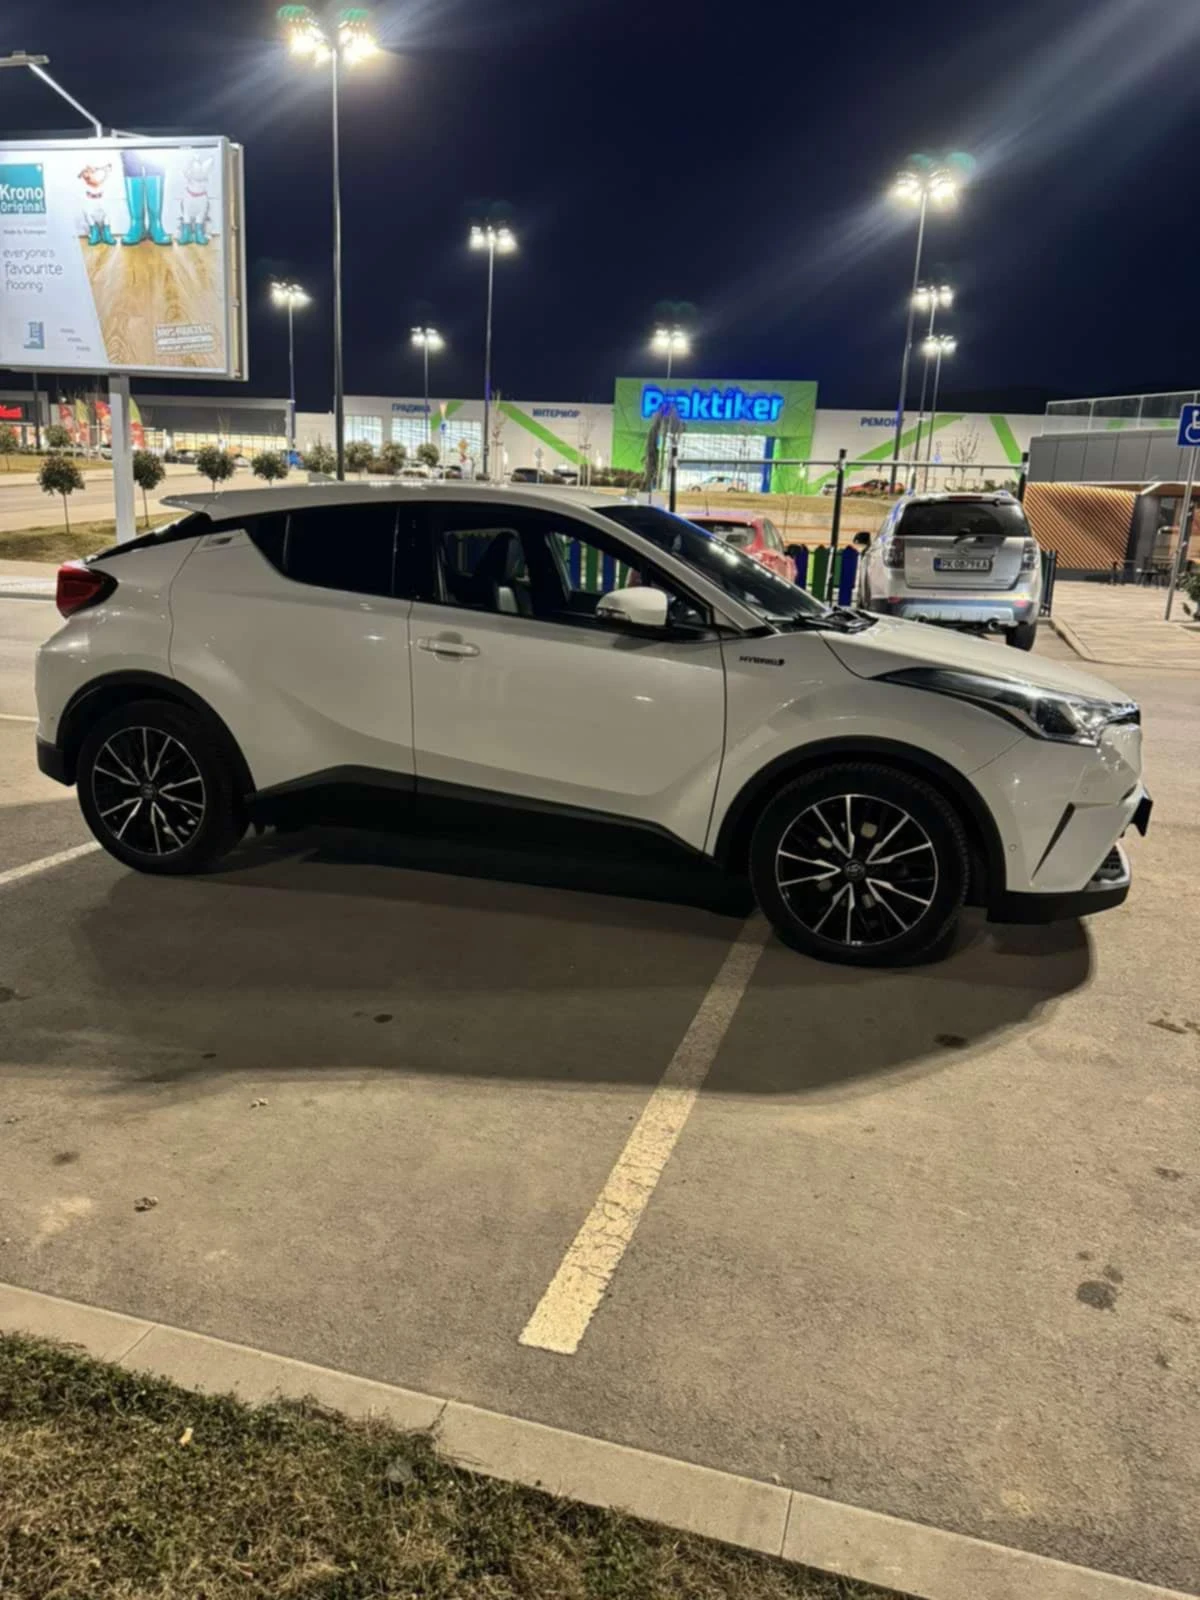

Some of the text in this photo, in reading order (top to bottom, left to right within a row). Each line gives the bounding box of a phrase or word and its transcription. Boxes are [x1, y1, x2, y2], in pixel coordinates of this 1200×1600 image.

[0, 184, 44, 200] Krono
[1, 200, 45, 214] Original
[5, 260, 63, 278] favourite
[6, 279, 44, 293] flooring
[641, 386, 784, 421] Praktiker
